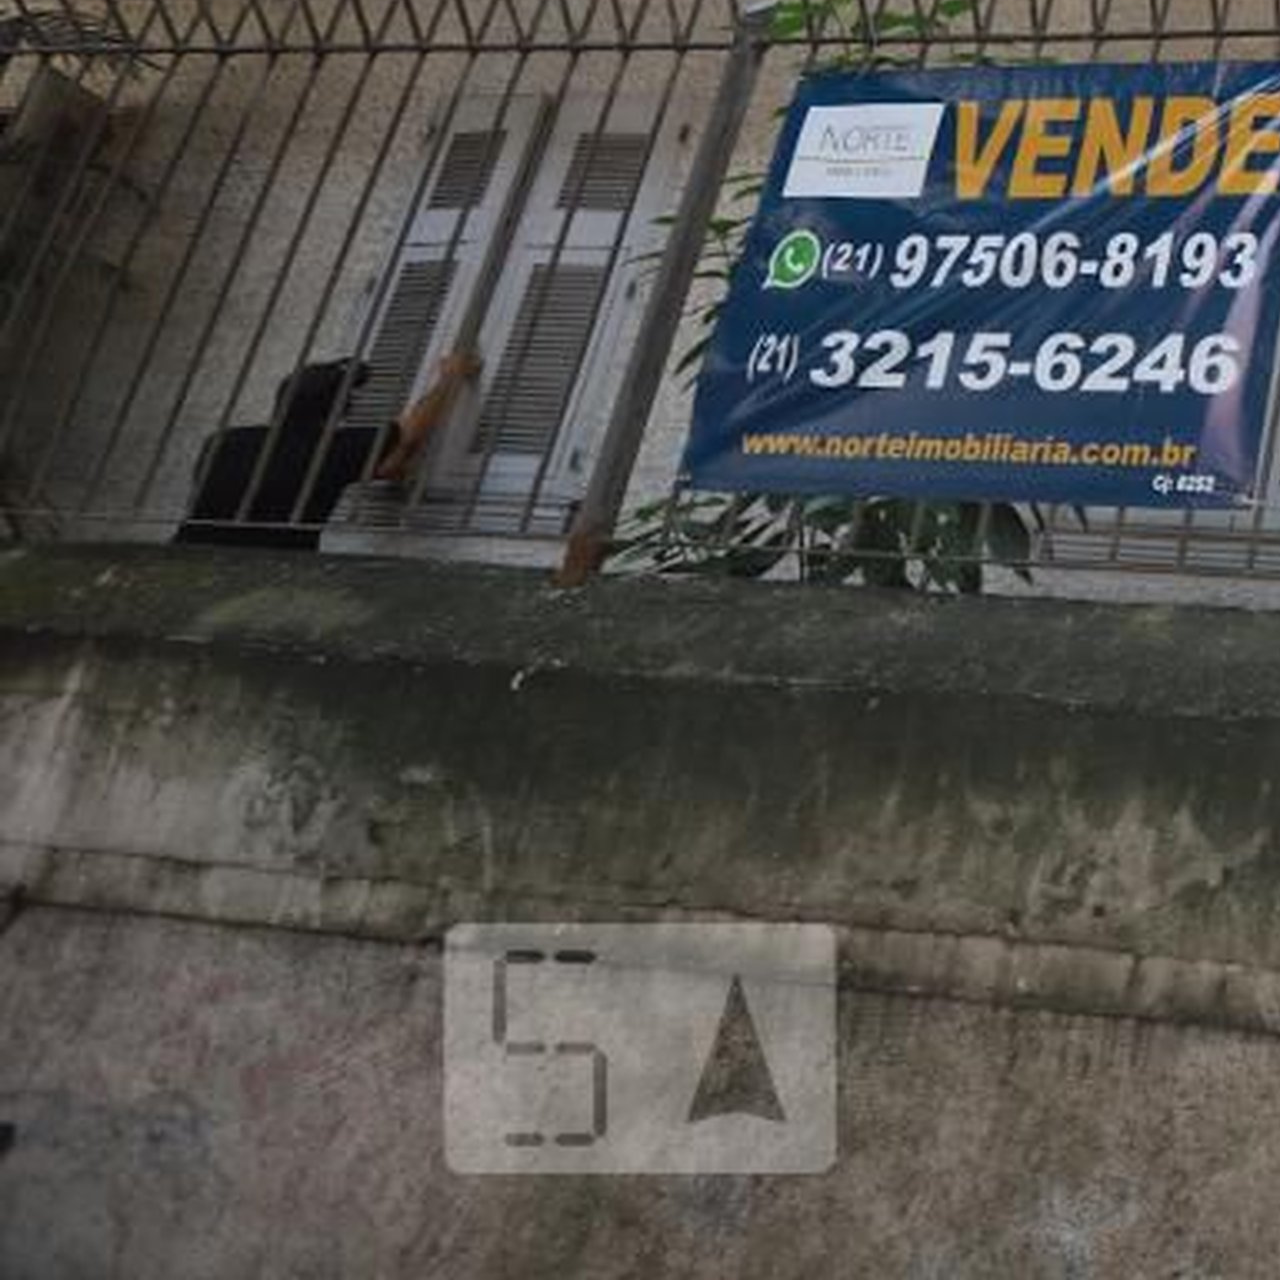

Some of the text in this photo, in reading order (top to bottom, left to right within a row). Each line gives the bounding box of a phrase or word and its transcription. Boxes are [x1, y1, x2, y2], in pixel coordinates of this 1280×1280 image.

[818, 123, 908, 152] NORTE
[822, 231, 1257, 289] (21) 97506-8193
[747, 329, 1240, 394] (21) 3215-6246
[741, 428, 1197, 468] www.norteimobiliaria.com.br
